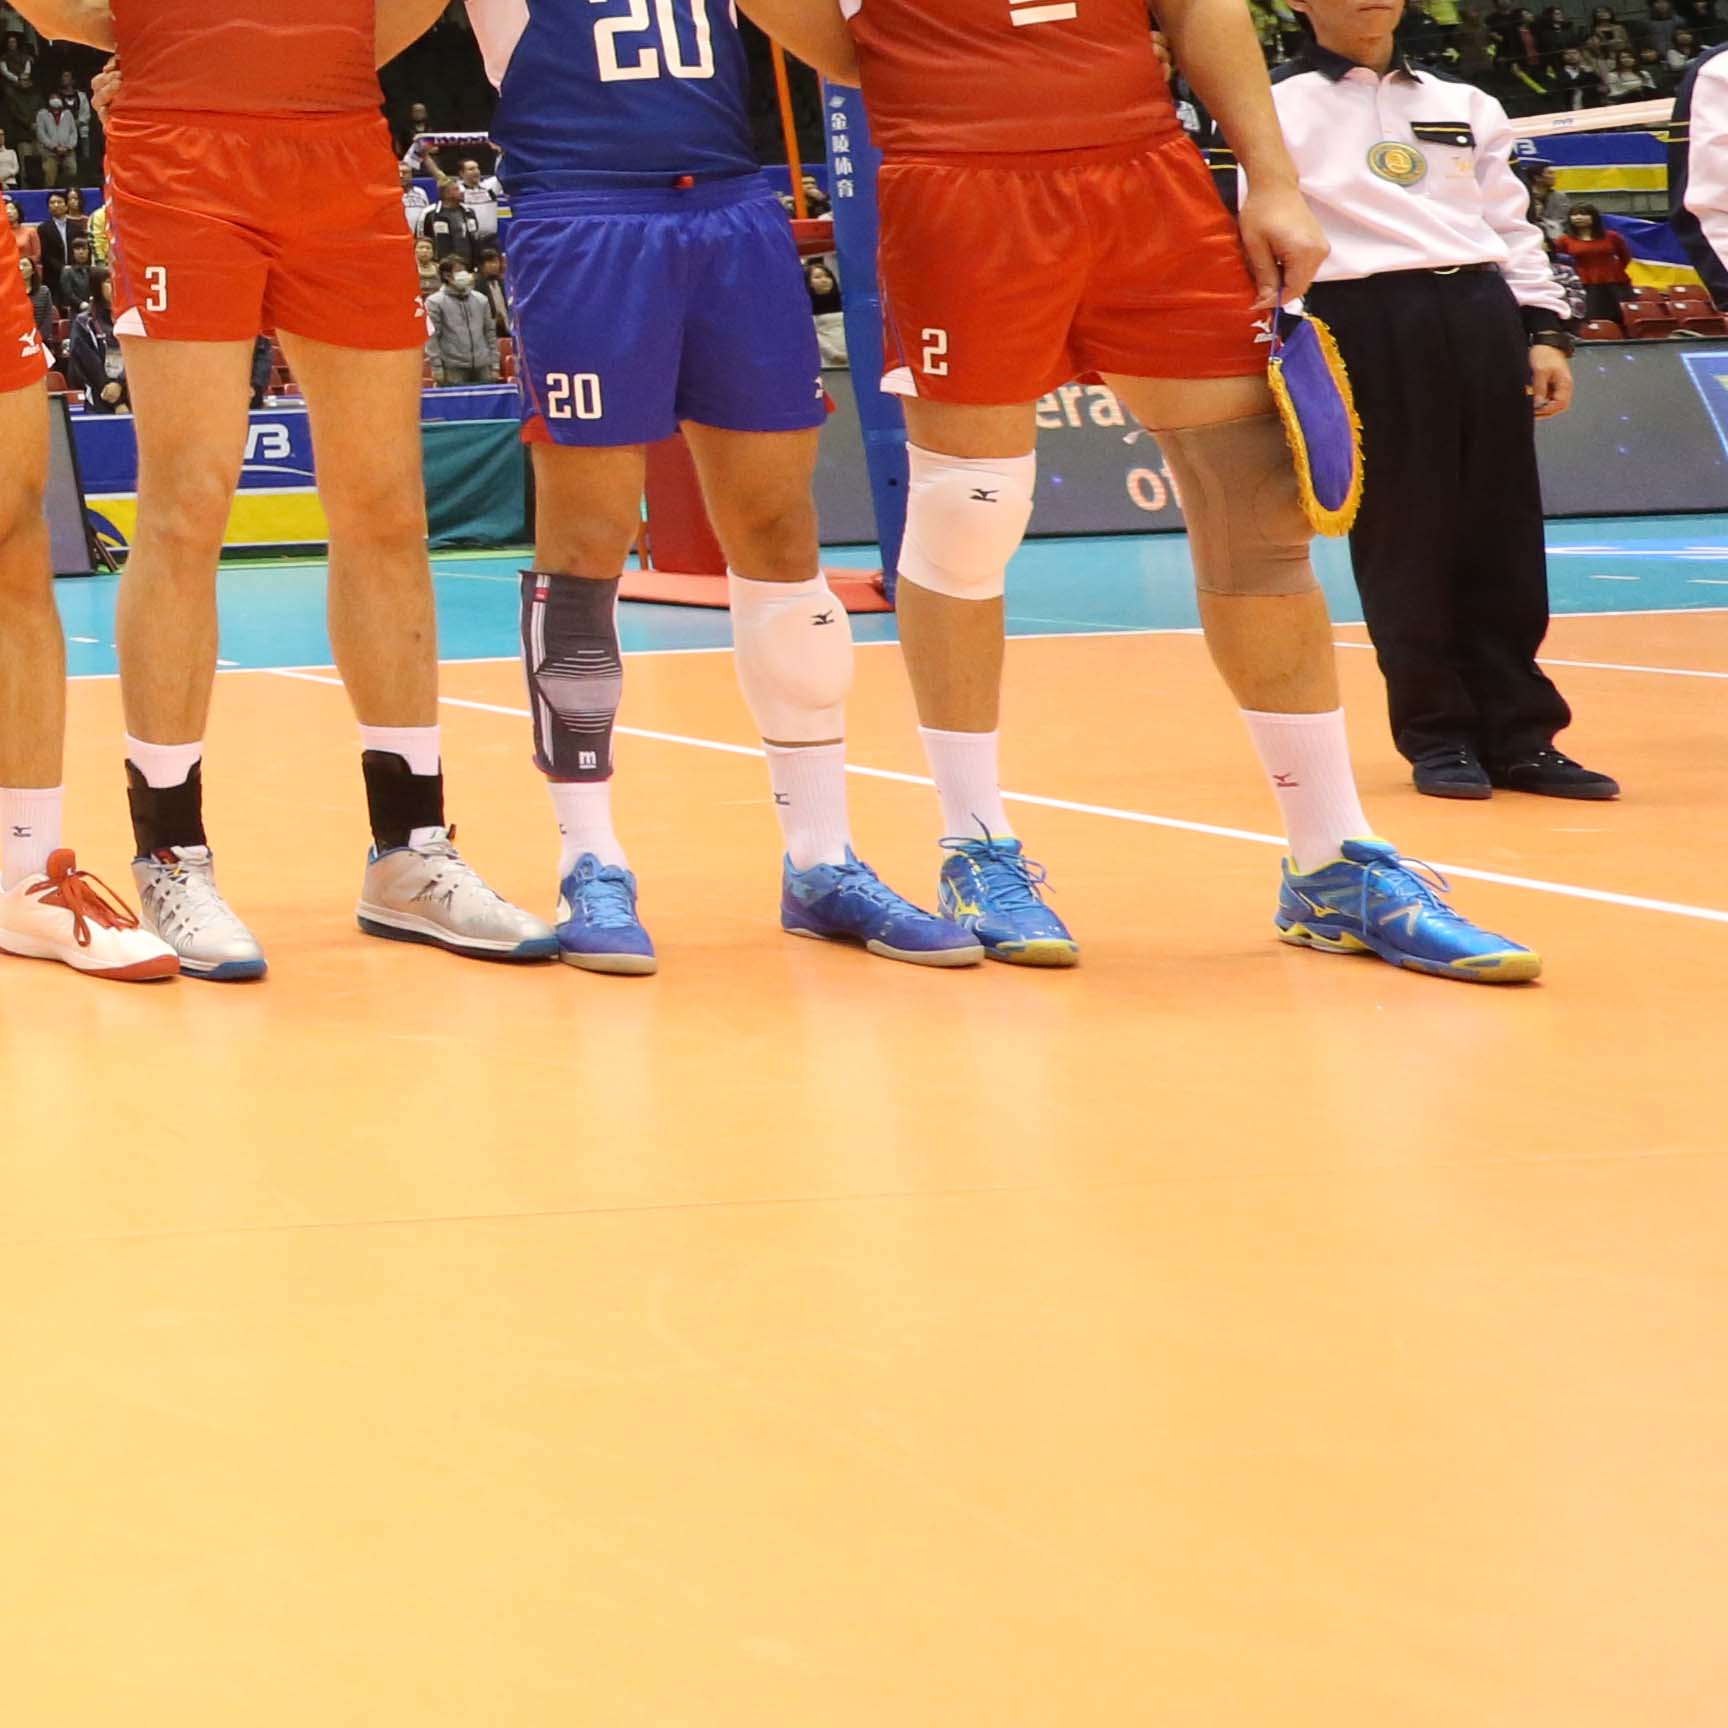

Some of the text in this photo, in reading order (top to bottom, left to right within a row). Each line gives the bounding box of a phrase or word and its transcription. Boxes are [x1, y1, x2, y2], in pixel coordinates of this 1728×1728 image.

[146, 266, 167, 311] 3
[922, 327, 948, 376] 2
[546, 373, 603, 419] 20
